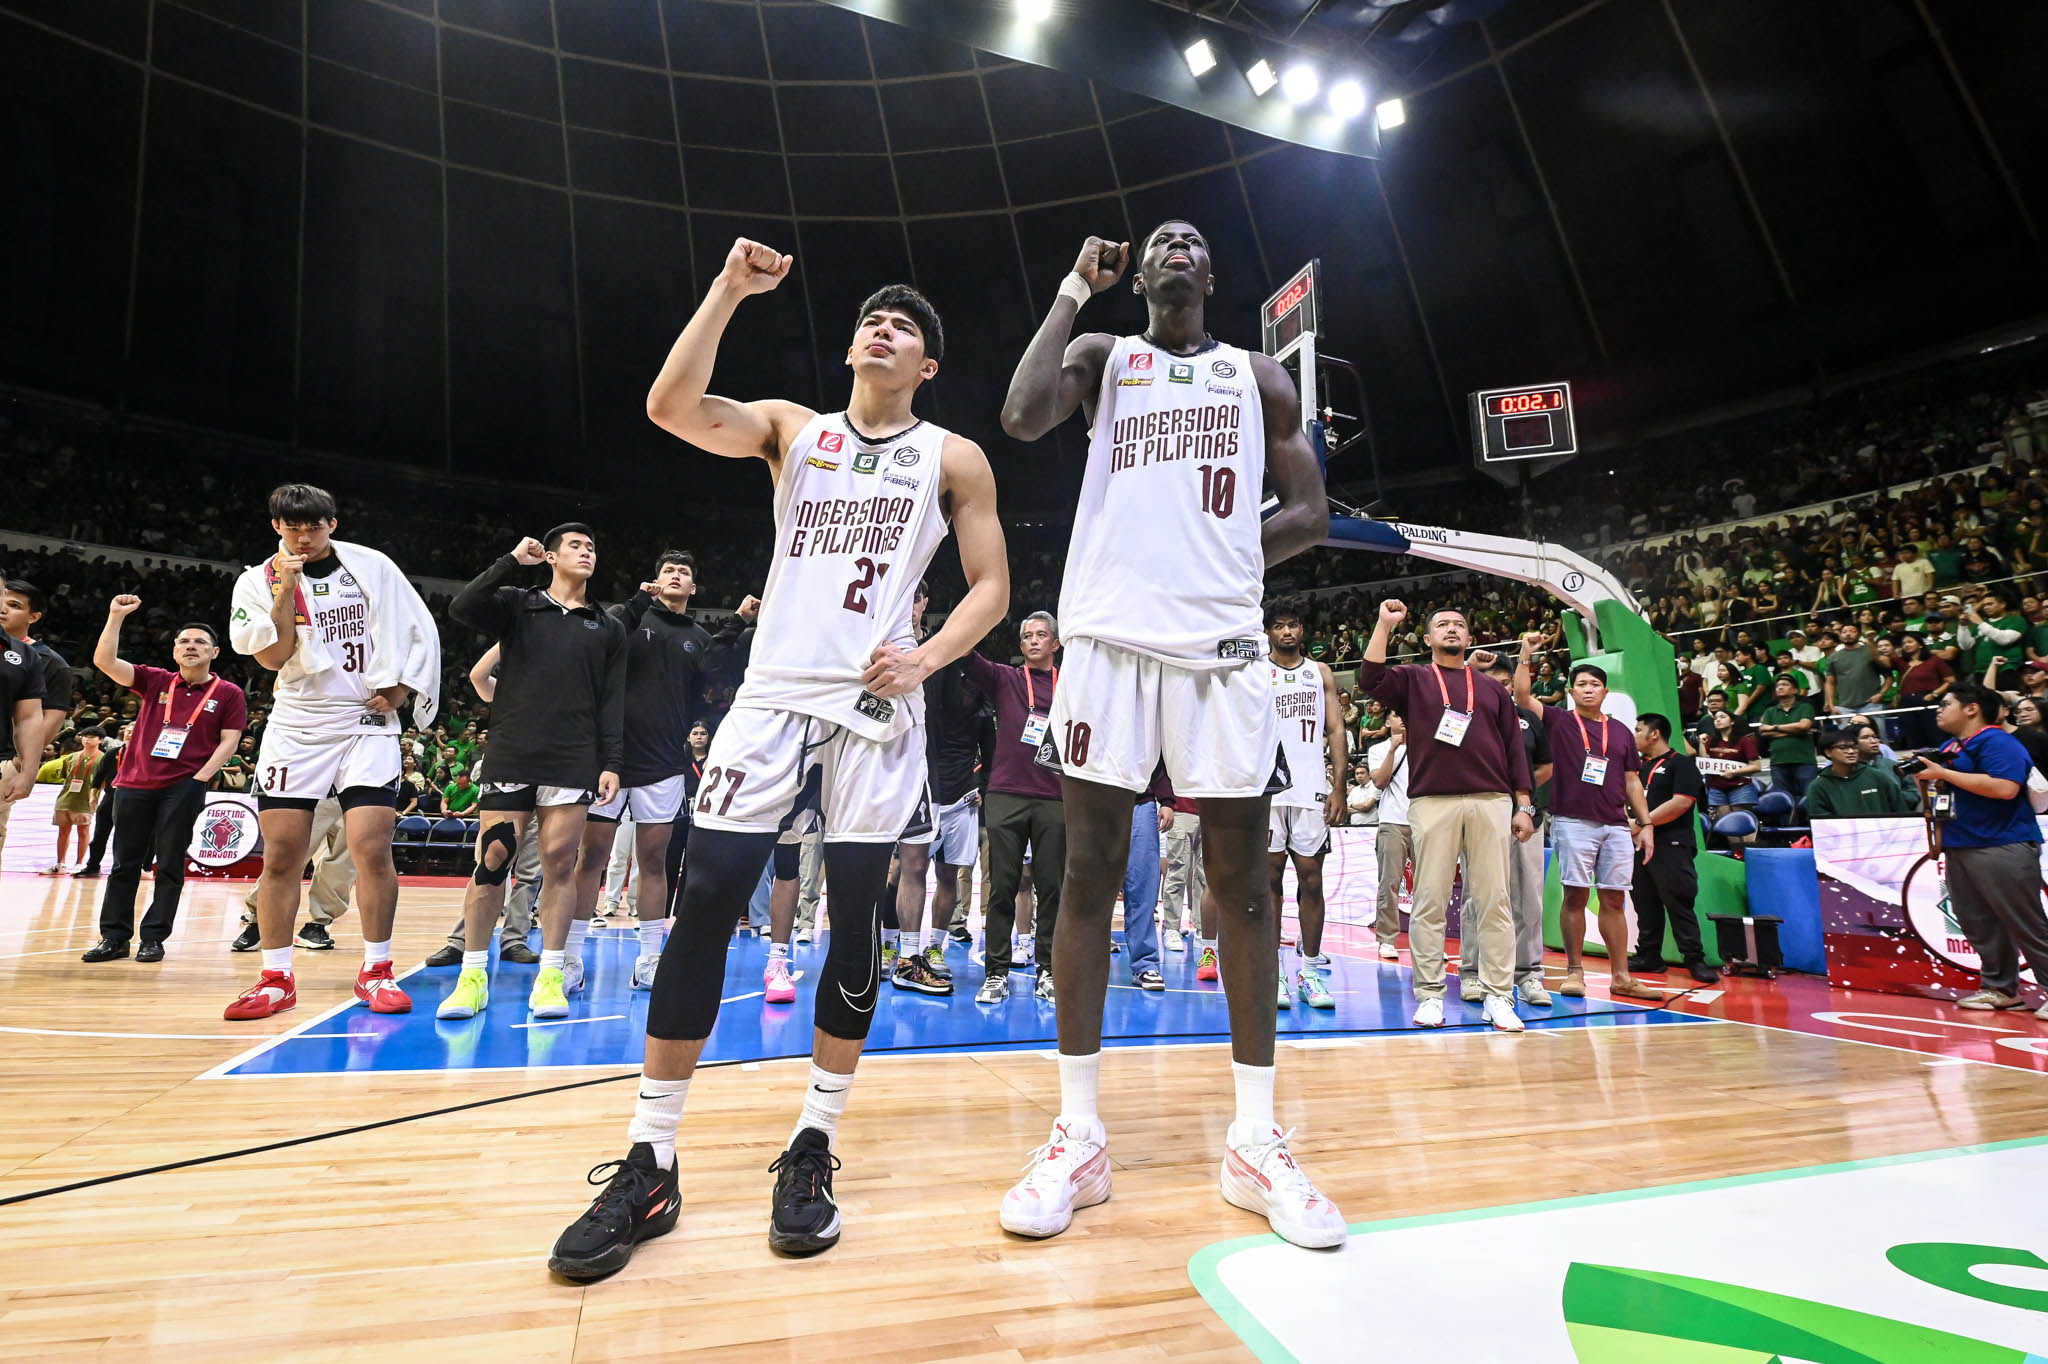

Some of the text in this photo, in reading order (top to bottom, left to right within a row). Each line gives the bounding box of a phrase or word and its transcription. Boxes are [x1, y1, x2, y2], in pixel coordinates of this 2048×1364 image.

[1500, 392, 1560, 413] 0:02.1
[1113, 404, 1239, 445] UNIBERSIDAD
[1111, 431, 1238, 474] NG PILIPINAS
[1197, 464, 1236, 519] 10
[784, 525, 904, 558] G PILIPINAS
[1395, 523, 1447, 544] SPALDING
[315, 603, 364, 628] RSIDAD
[322, 620, 364, 644] IPINAS
[342, 641, 364, 673] 31
[1064, 720, 1092, 768] 10
[1300, 718, 1317, 744] 17
[264, 766, 288, 792] 31
[696, 766, 747, 817] 27
[206, 809, 246, 819] FIGHTING
[1946, 938, 1976, 955] MA
